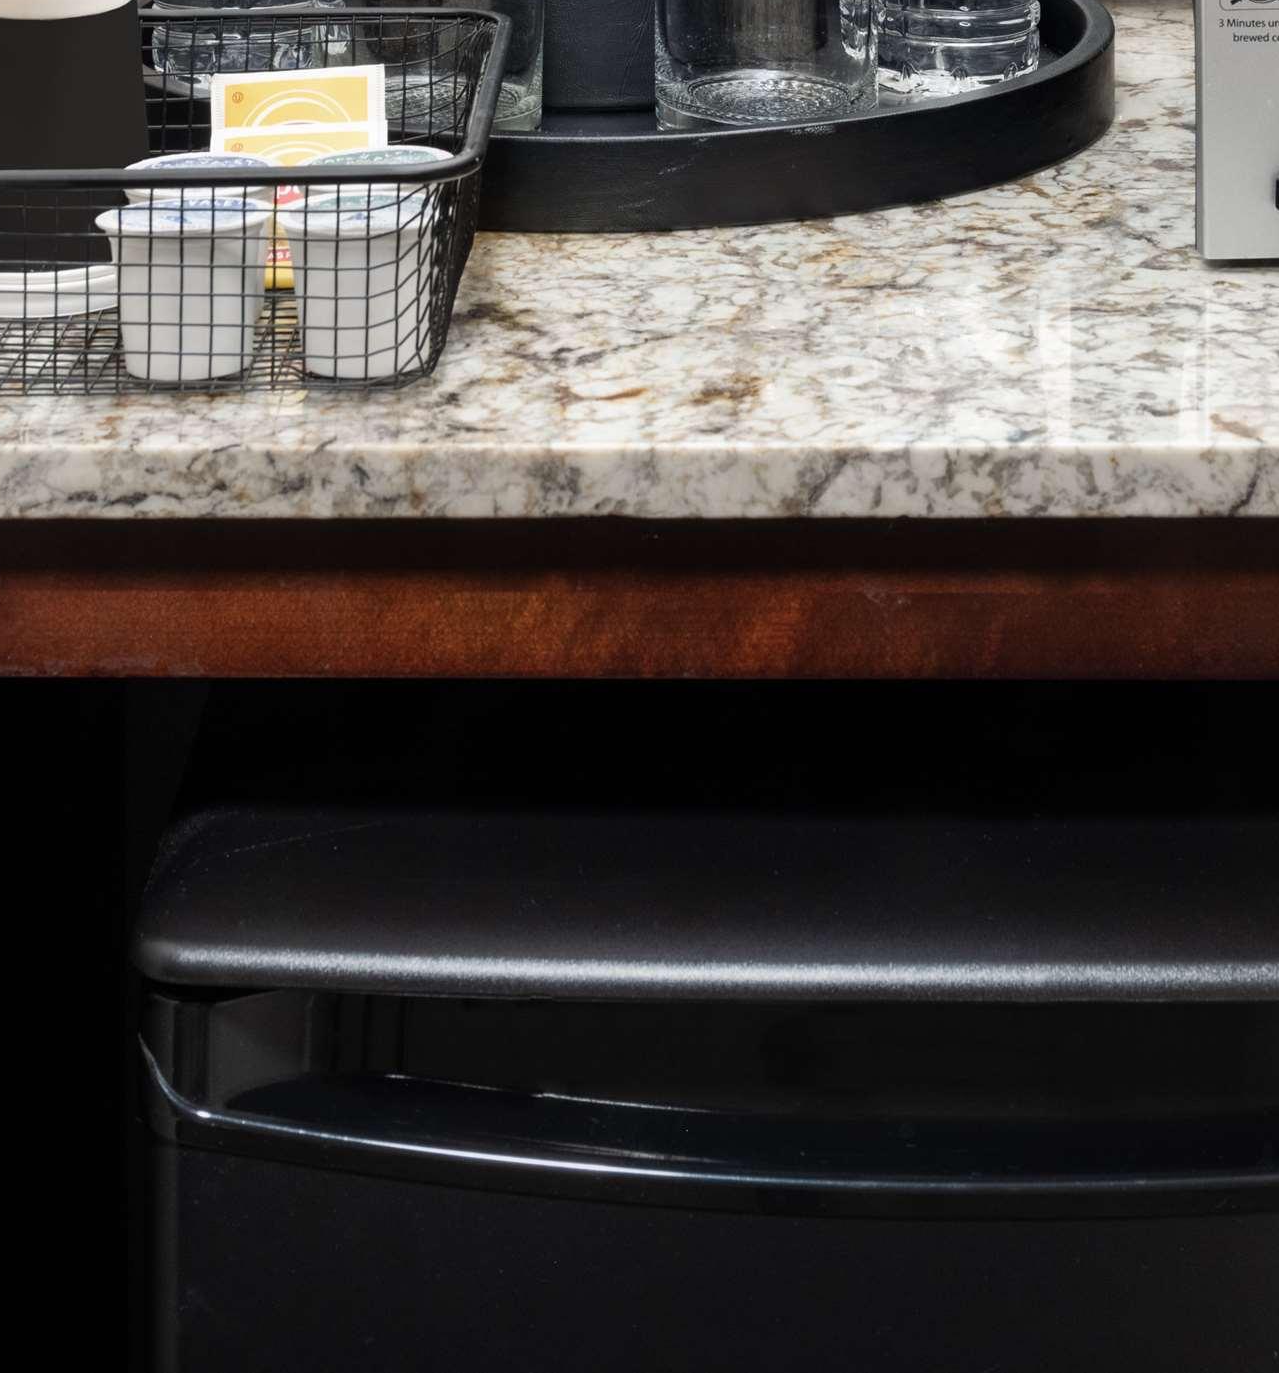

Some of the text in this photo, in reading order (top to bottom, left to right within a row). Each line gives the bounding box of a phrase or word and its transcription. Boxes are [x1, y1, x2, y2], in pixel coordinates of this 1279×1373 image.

[1219, 18, 1225, 28] 3
[1227, 18, 1266, 28] Minutes
[1232, 32, 1270, 43] brewed
